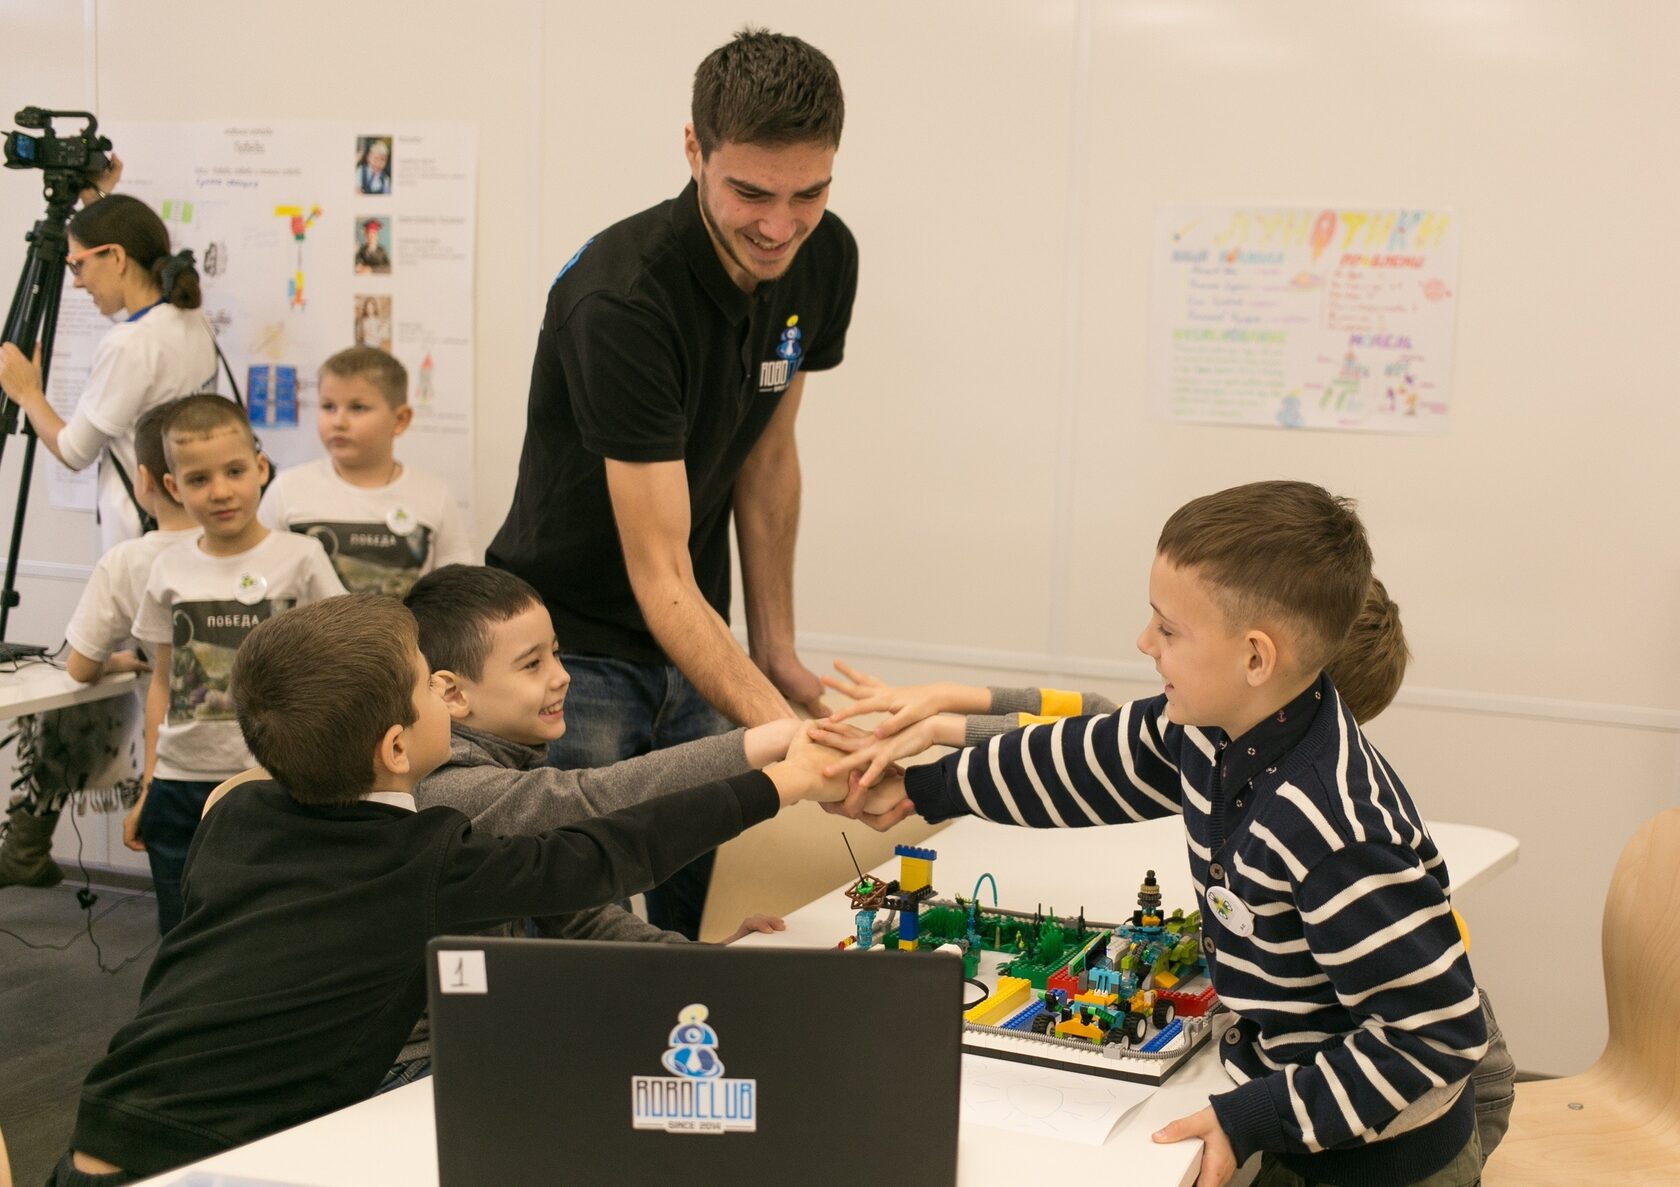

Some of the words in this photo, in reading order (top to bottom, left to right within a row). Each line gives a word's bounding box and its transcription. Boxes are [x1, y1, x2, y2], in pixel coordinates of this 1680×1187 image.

[350, 533, 397, 547] ПОБЕДА
[207, 614, 260, 628] ПОБЕДА
[450, 956, 470, 987] 1
[636, 1080, 752, 1119] ROBOCLUB
[668, 1120, 695, 1129] SINCE
